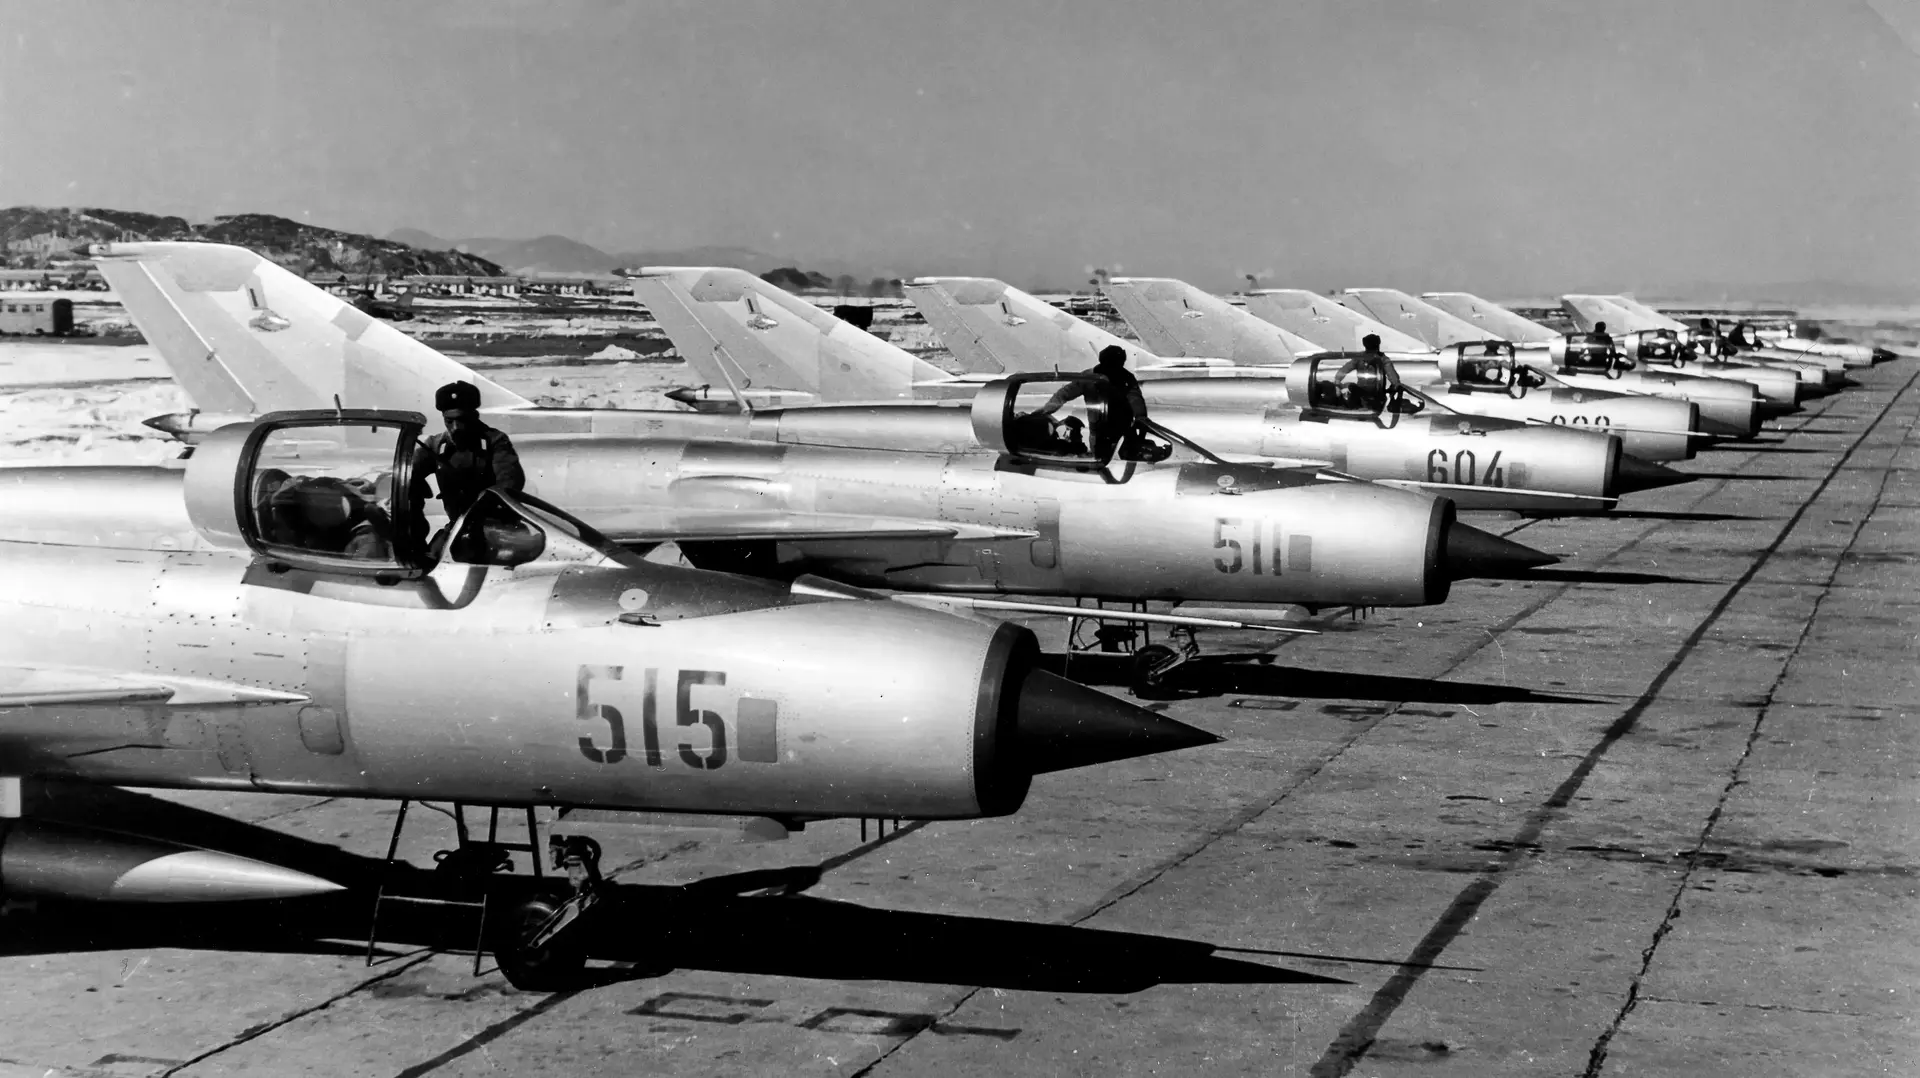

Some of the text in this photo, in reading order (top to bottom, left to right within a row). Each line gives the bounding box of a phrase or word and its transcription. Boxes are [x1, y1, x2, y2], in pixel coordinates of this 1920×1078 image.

[1427, 449, 1503, 487] 604
[1213, 517, 1282, 577] 511
[576, 664, 727, 770] 515
